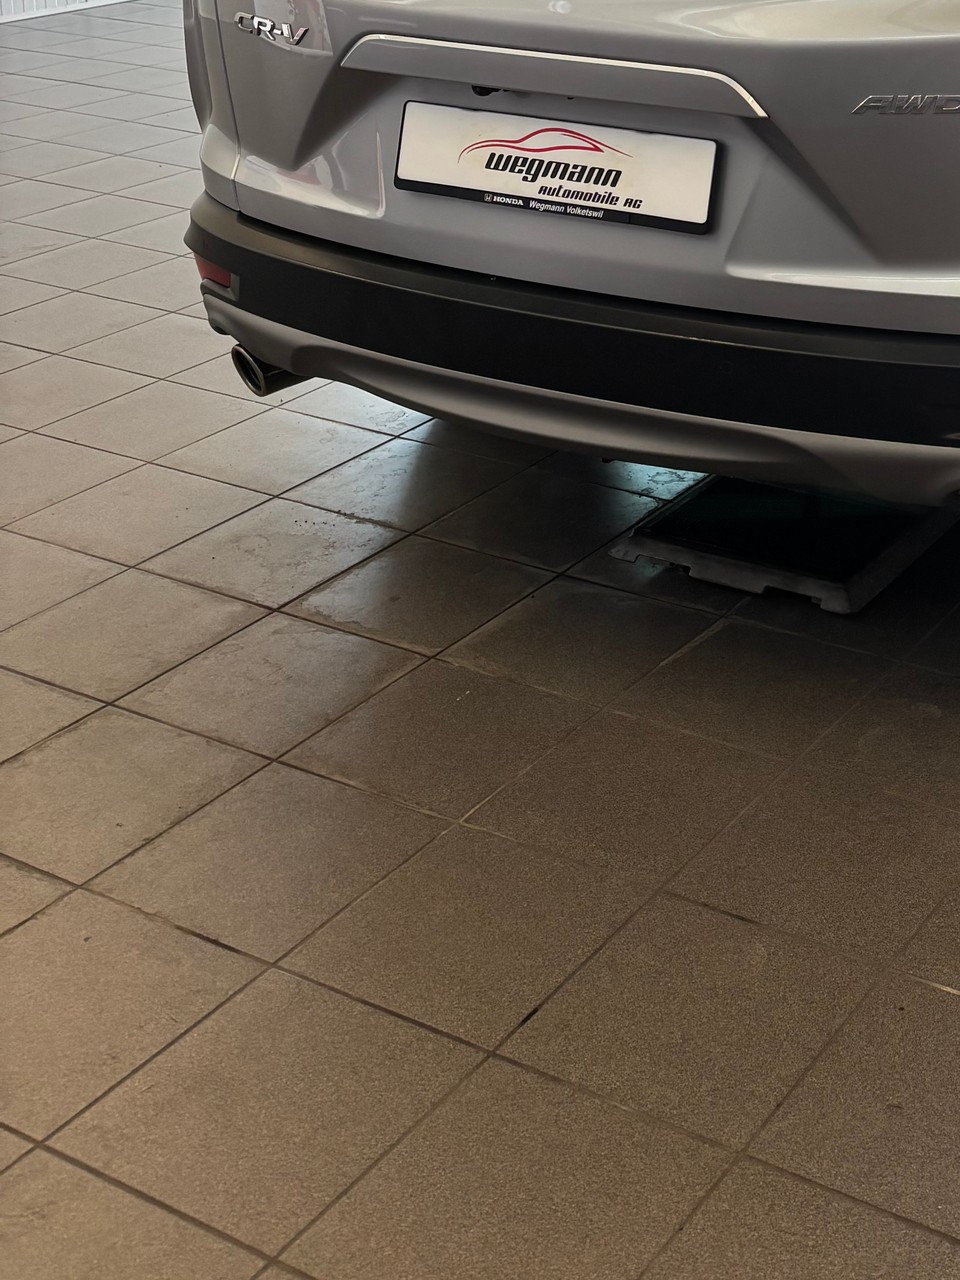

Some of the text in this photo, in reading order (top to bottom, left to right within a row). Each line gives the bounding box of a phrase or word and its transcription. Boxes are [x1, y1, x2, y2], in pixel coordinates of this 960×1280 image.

[234, 11, 309, 45] CR-V
[493, 195, 524, 206] HONDA
[529, 200, 565, 213] Wegmann
[566, 205, 604, 218] Volketswil
[623, 198, 643, 209] AG
